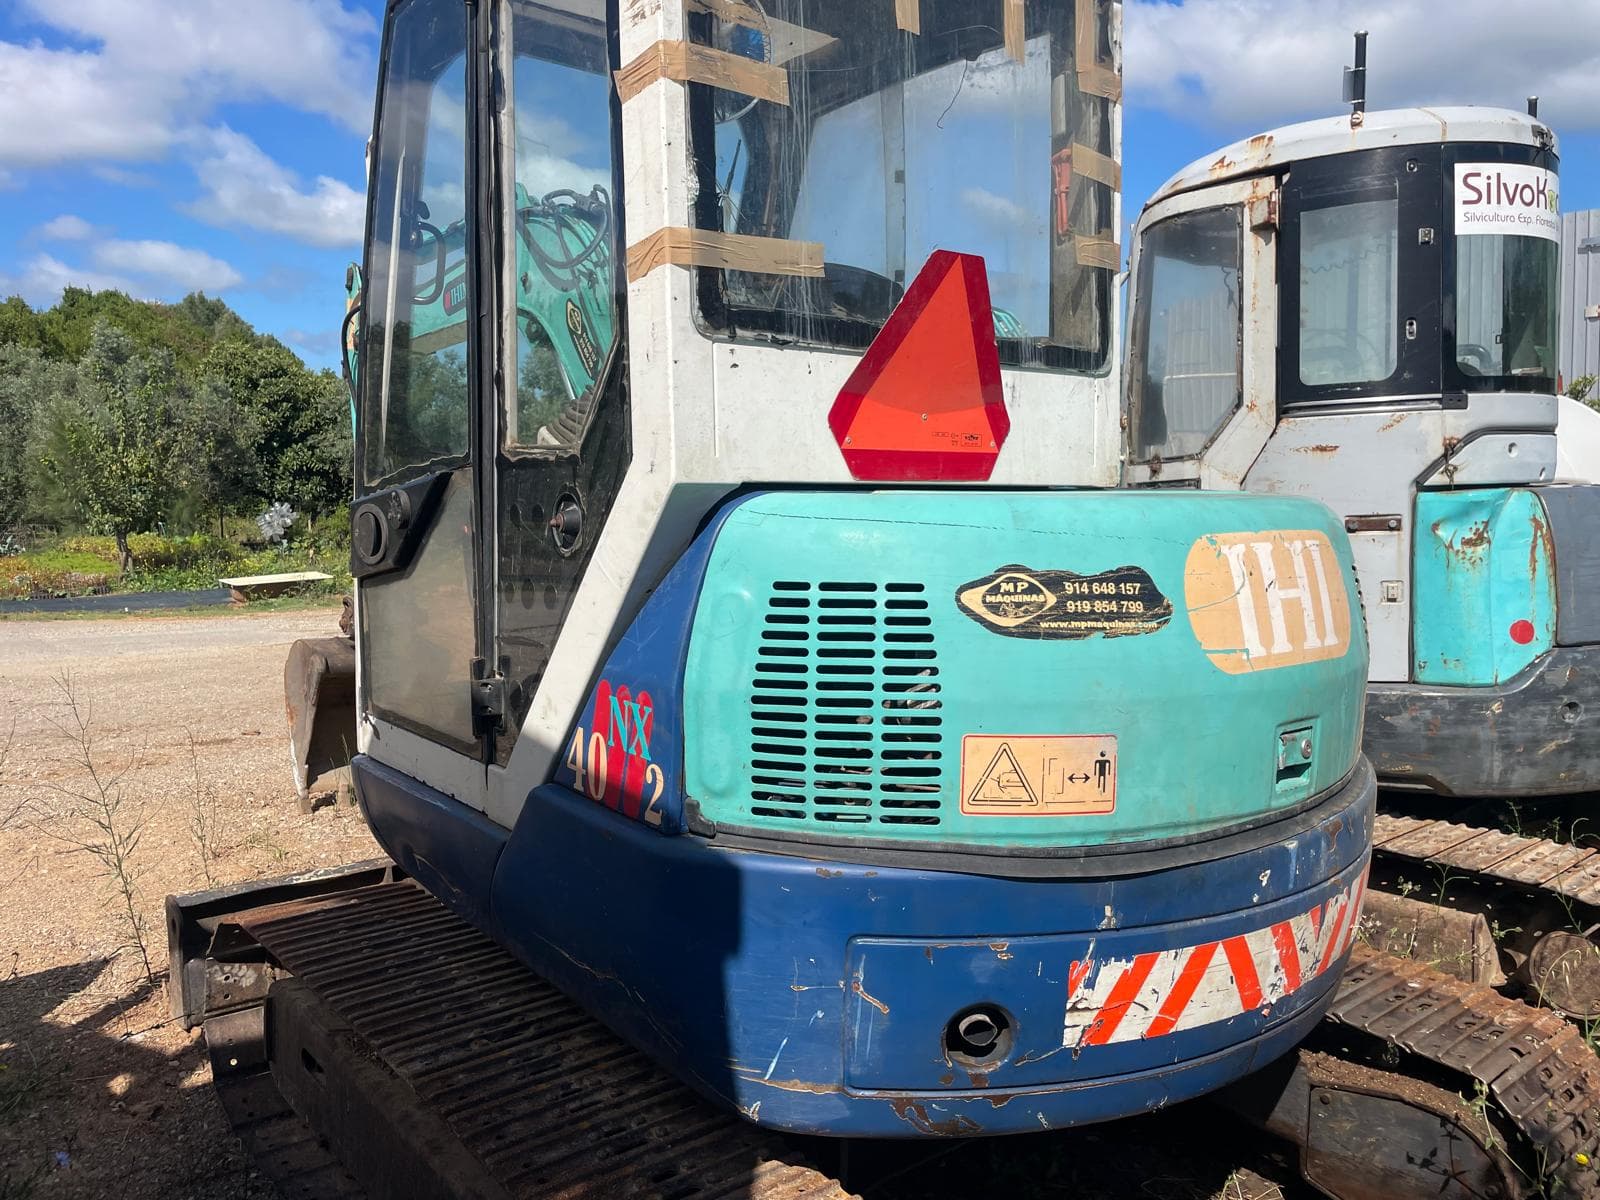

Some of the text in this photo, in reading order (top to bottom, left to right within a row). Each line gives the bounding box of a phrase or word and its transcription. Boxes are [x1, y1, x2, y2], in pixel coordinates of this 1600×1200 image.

[1064, 582, 1141, 595] 914 648 157
[1220, 539, 1339, 659] IHI
[1066, 600, 1144, 613] 919 854 799
[1040, 619, 1158, 630] www.mpmaquinascom
[566, 695, 664, 826] 40 NX 2
